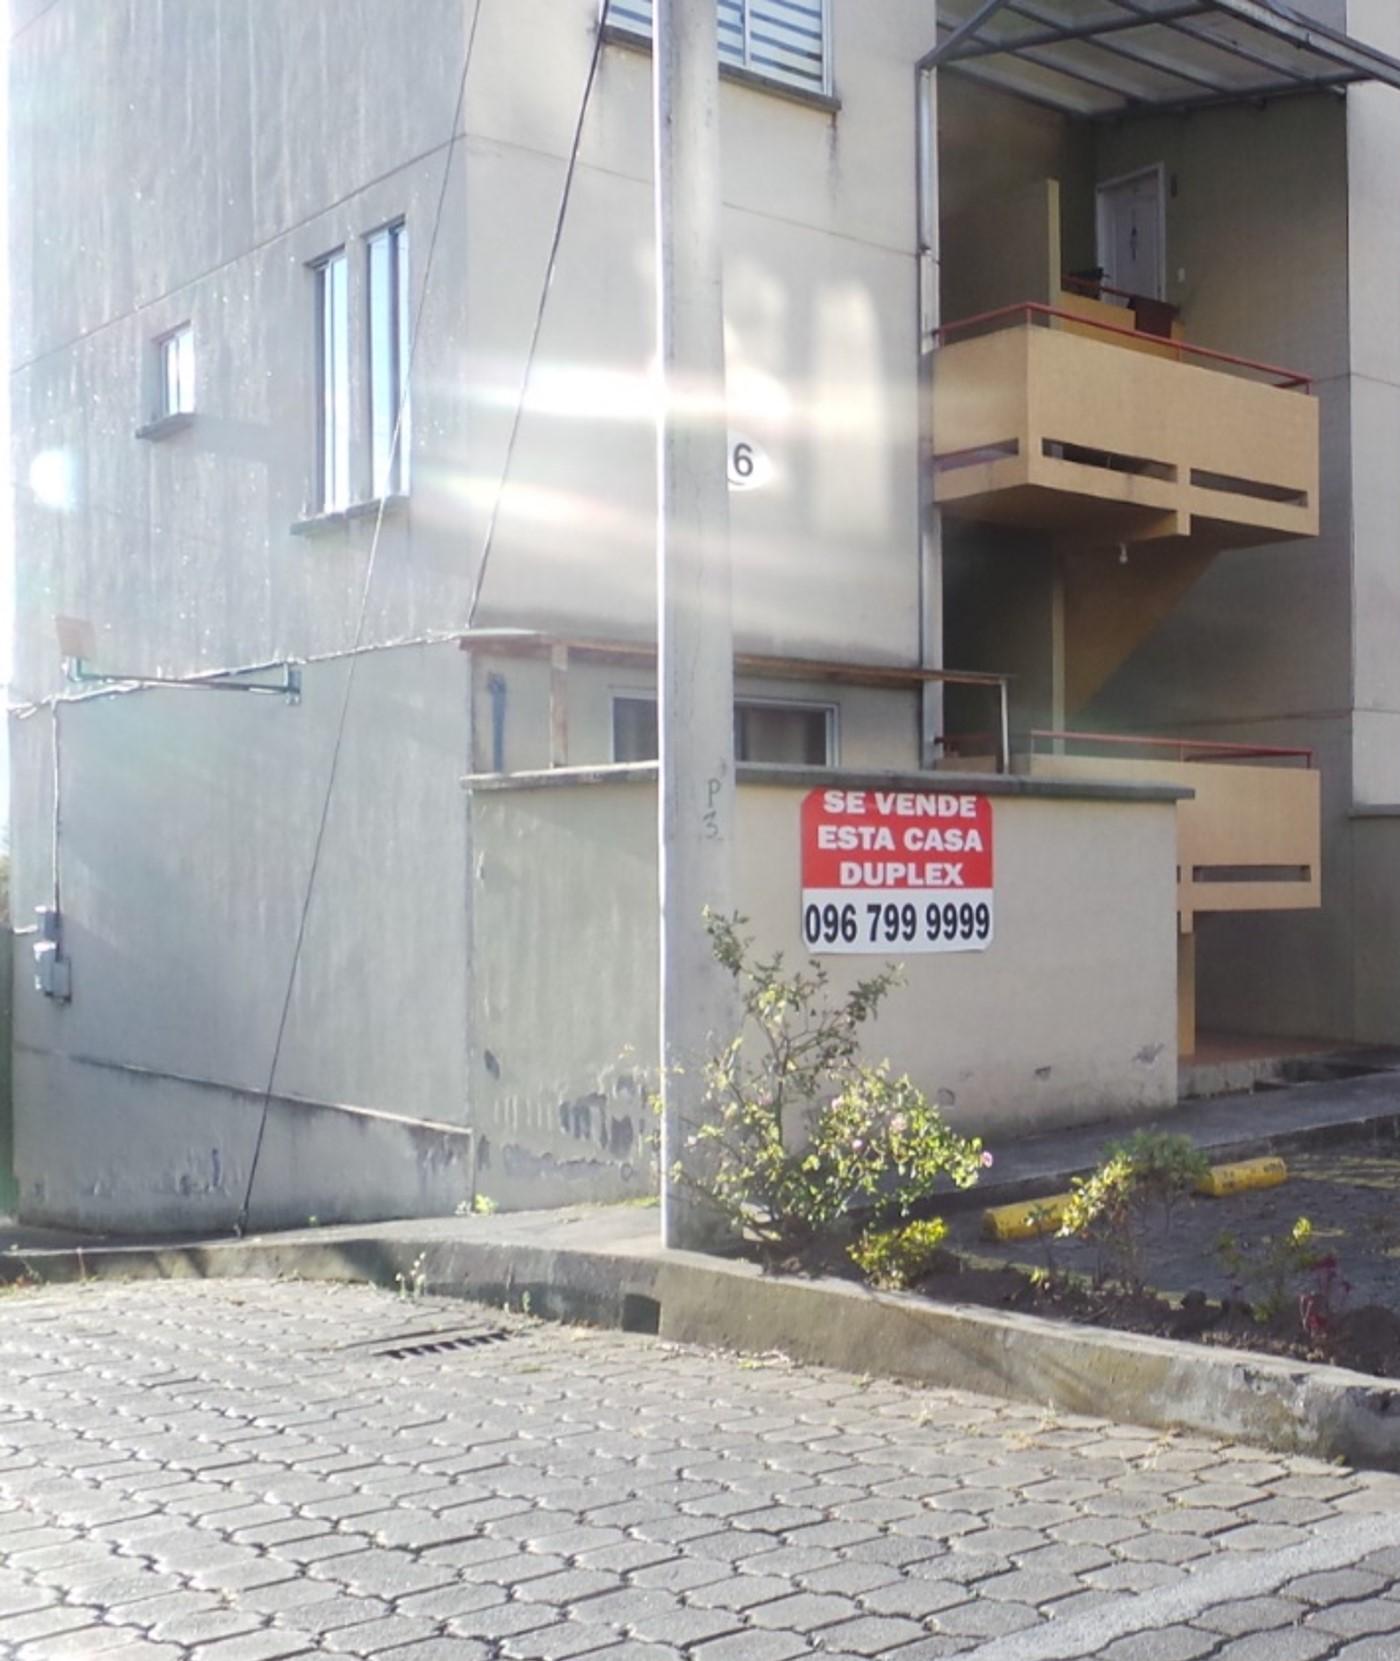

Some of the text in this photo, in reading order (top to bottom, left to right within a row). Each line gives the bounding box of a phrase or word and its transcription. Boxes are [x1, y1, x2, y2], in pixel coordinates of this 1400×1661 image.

[733, 442, 754, 477] 6
[823, 789, 977, 817] SE VENDE
[817, 825, 984, 852] ESTA CASA
[839, 861, 964, 886] DUPLEX
[805, 902, 990, 944] 096 799 9999
